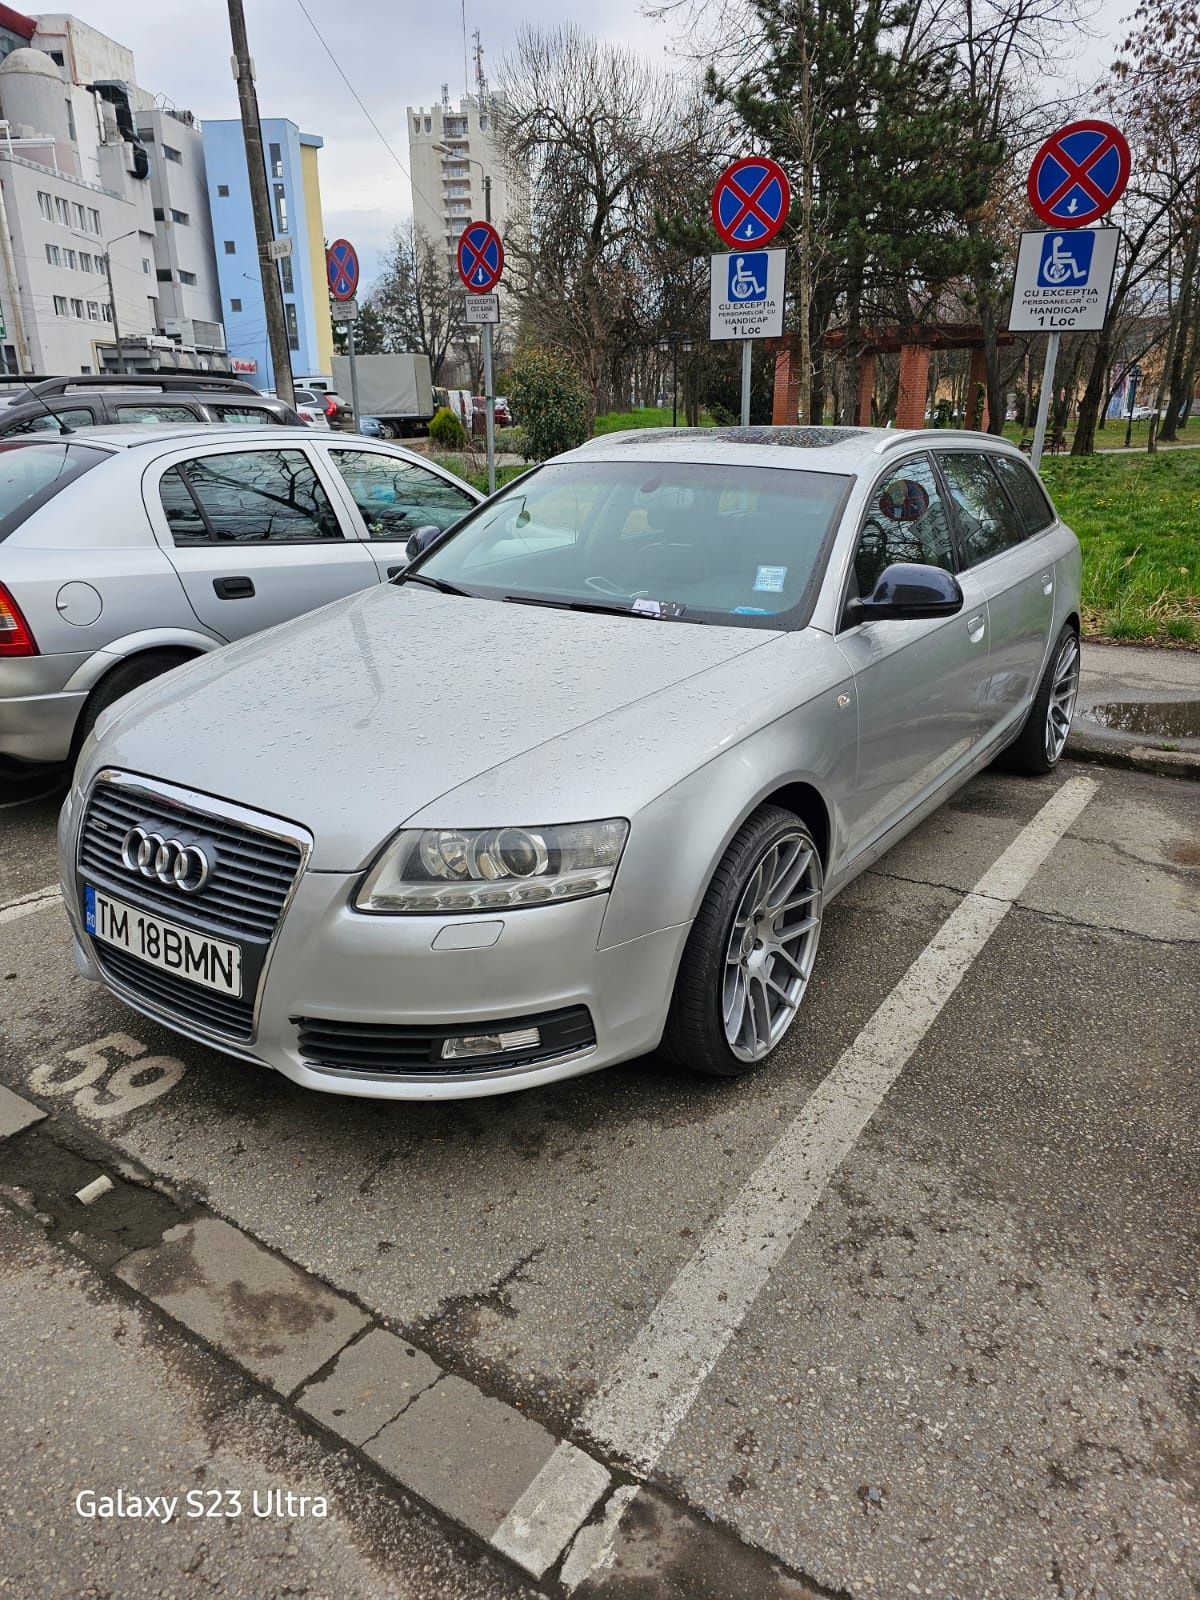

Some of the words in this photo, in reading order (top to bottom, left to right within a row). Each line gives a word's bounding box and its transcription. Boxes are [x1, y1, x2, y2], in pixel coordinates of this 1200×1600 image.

[1030, 306, 1087, 314] HANDICAP
[725, 317, 768, 325] HANDICAP
[1038, 316, 1044, 326] 1
[732, 326, 737, 335] 1
[86, 912, 96, 928] RO
[97, 897, 129, 947] TM
